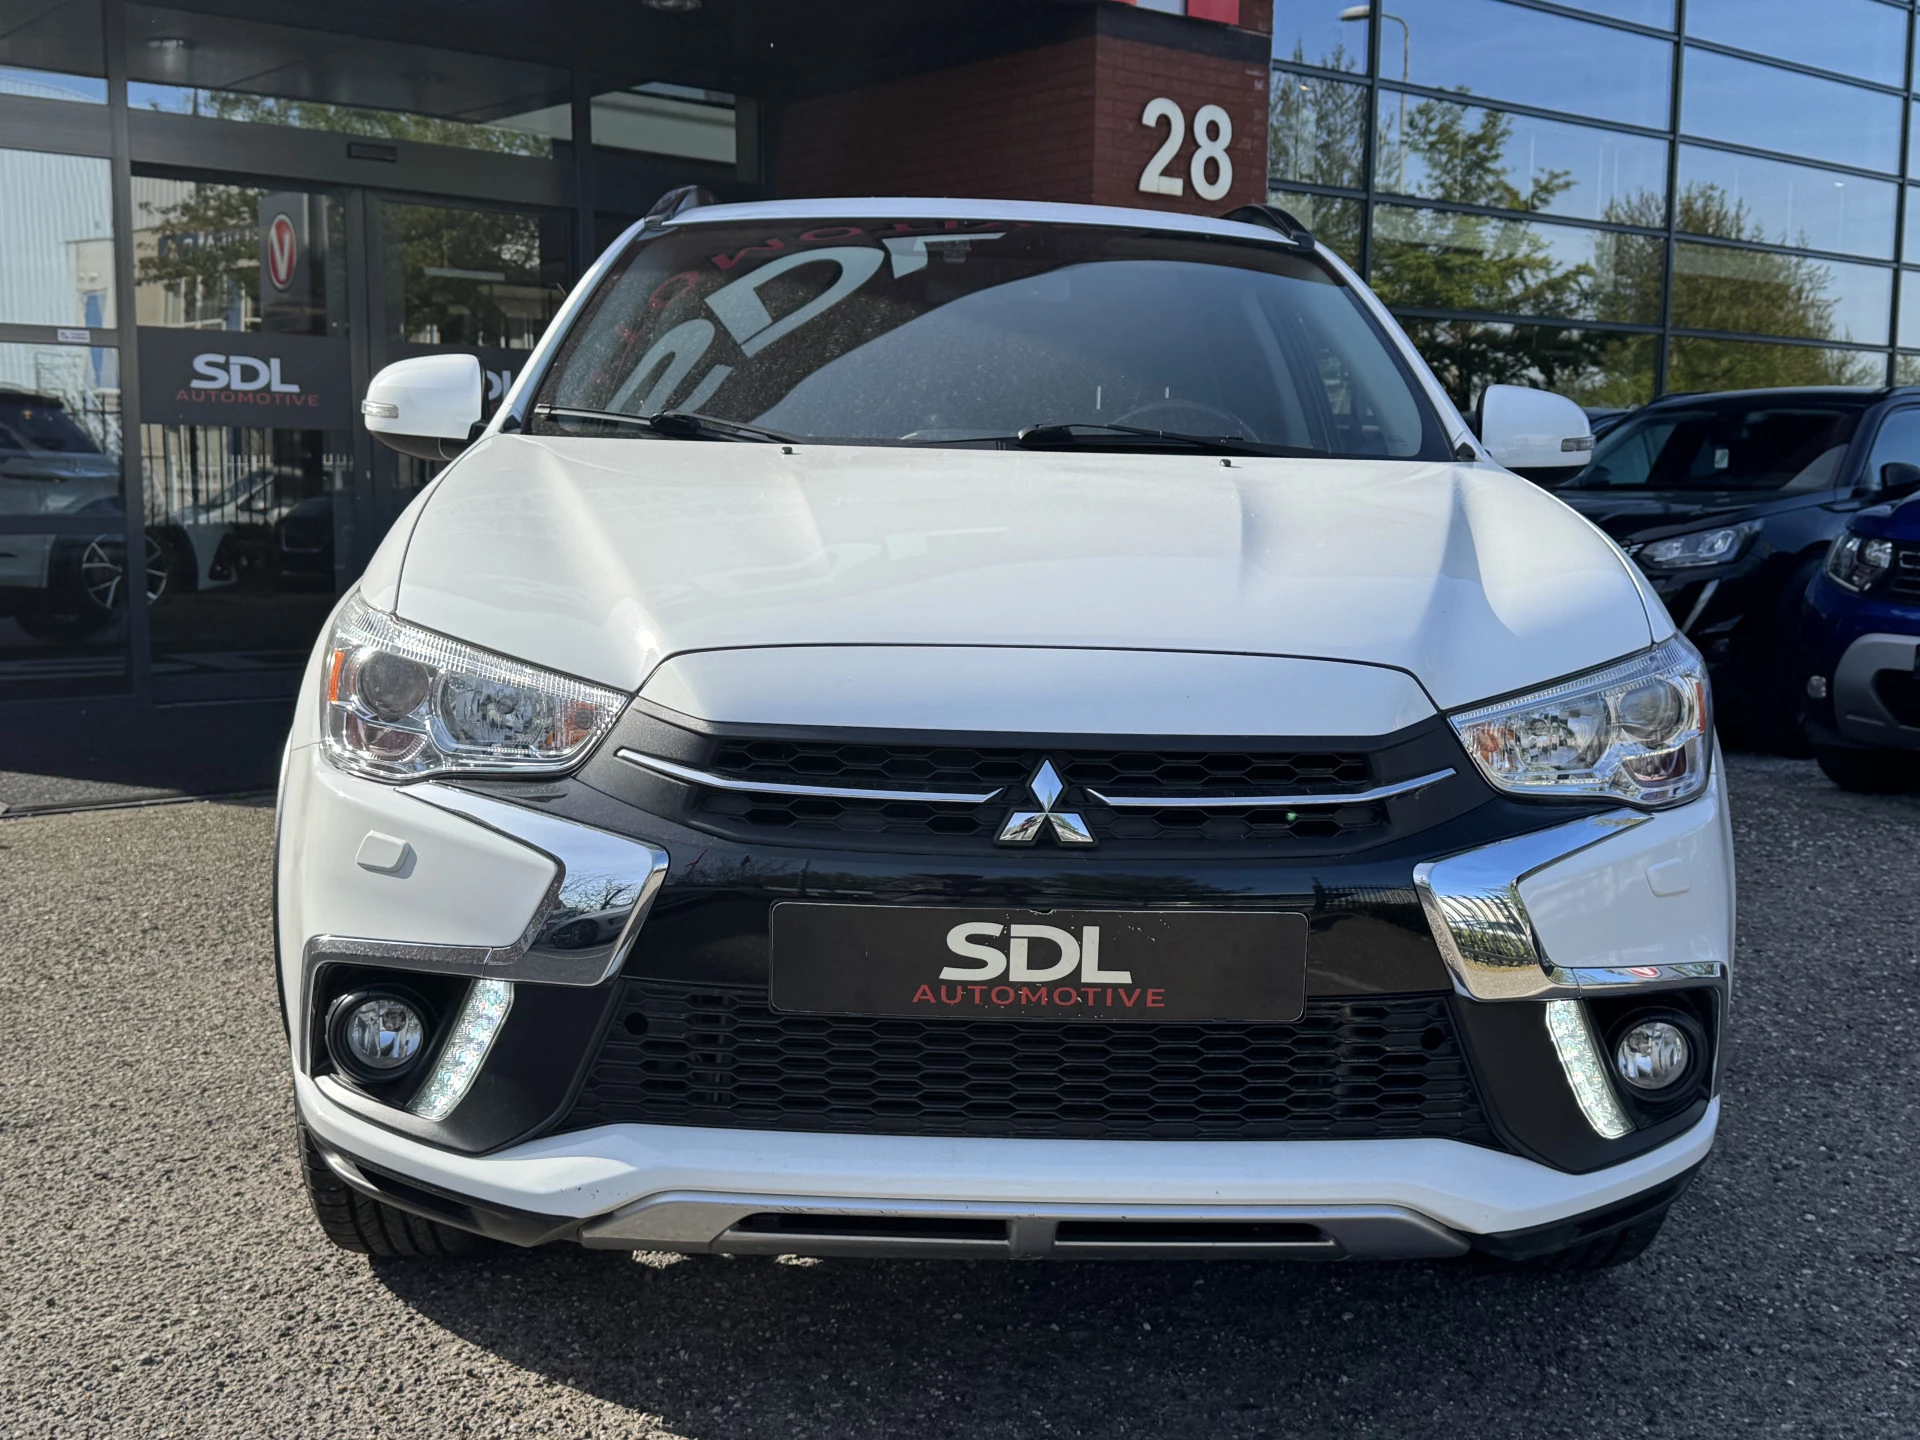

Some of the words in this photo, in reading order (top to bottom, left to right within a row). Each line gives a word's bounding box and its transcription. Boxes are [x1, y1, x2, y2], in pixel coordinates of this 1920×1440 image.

[1139, 97, 1232, 201] 28
[190, 353, 300, 393] SDL
[176, 389, 319, 407] AUTOMOTIVE
[939, 922, 1132, 984] SDL
[912, 984, 1165, 1007] AUTOMOTIVE
